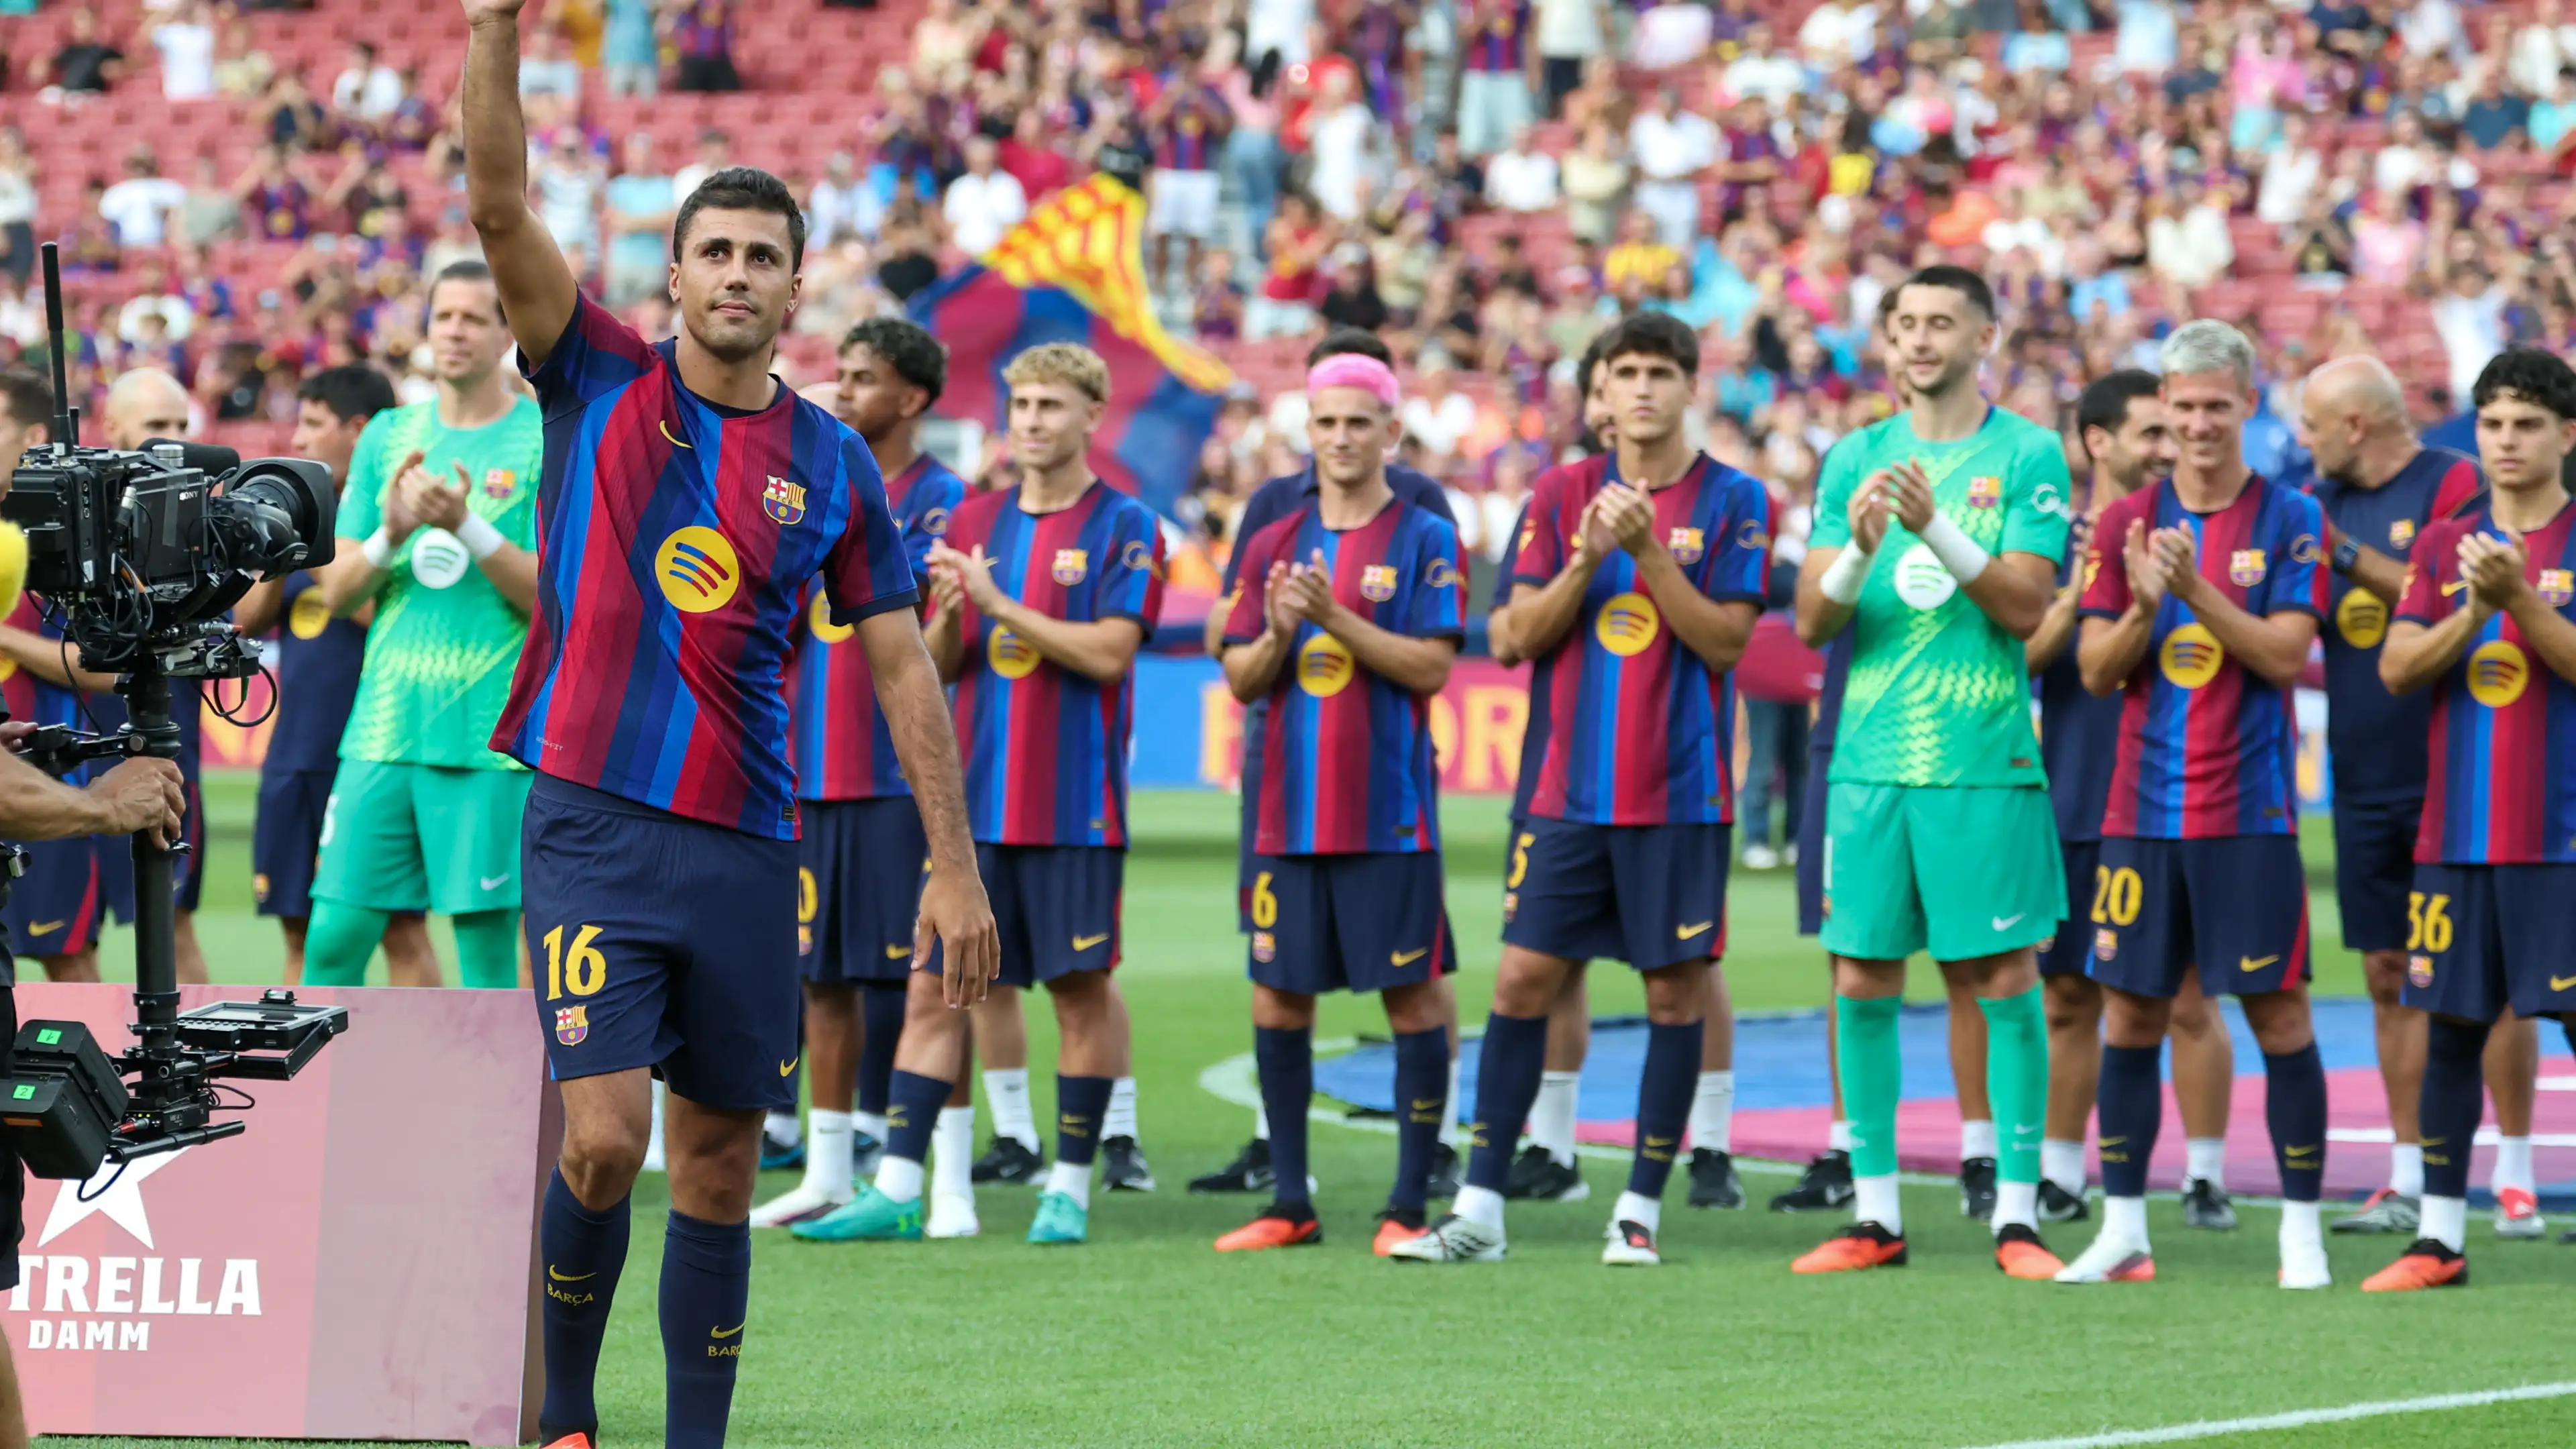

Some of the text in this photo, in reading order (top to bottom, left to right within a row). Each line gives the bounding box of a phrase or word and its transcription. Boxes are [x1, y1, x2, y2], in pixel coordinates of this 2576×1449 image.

[798, 866, 818, 924] 0
[1252, 870, 1278, 929] 6
[2090, 863, 2143, 926] 20
[543, 924, 606, 1001] 16
[19, 1087, 28, 1097] 2
[8, 1254, 262, 1316] TRELLA
[547, 1283, 594, 1306] BARÇA
[28, 1320, 150, 1351] DAMM
[708, 1344, 741, 1358] BARÇ
